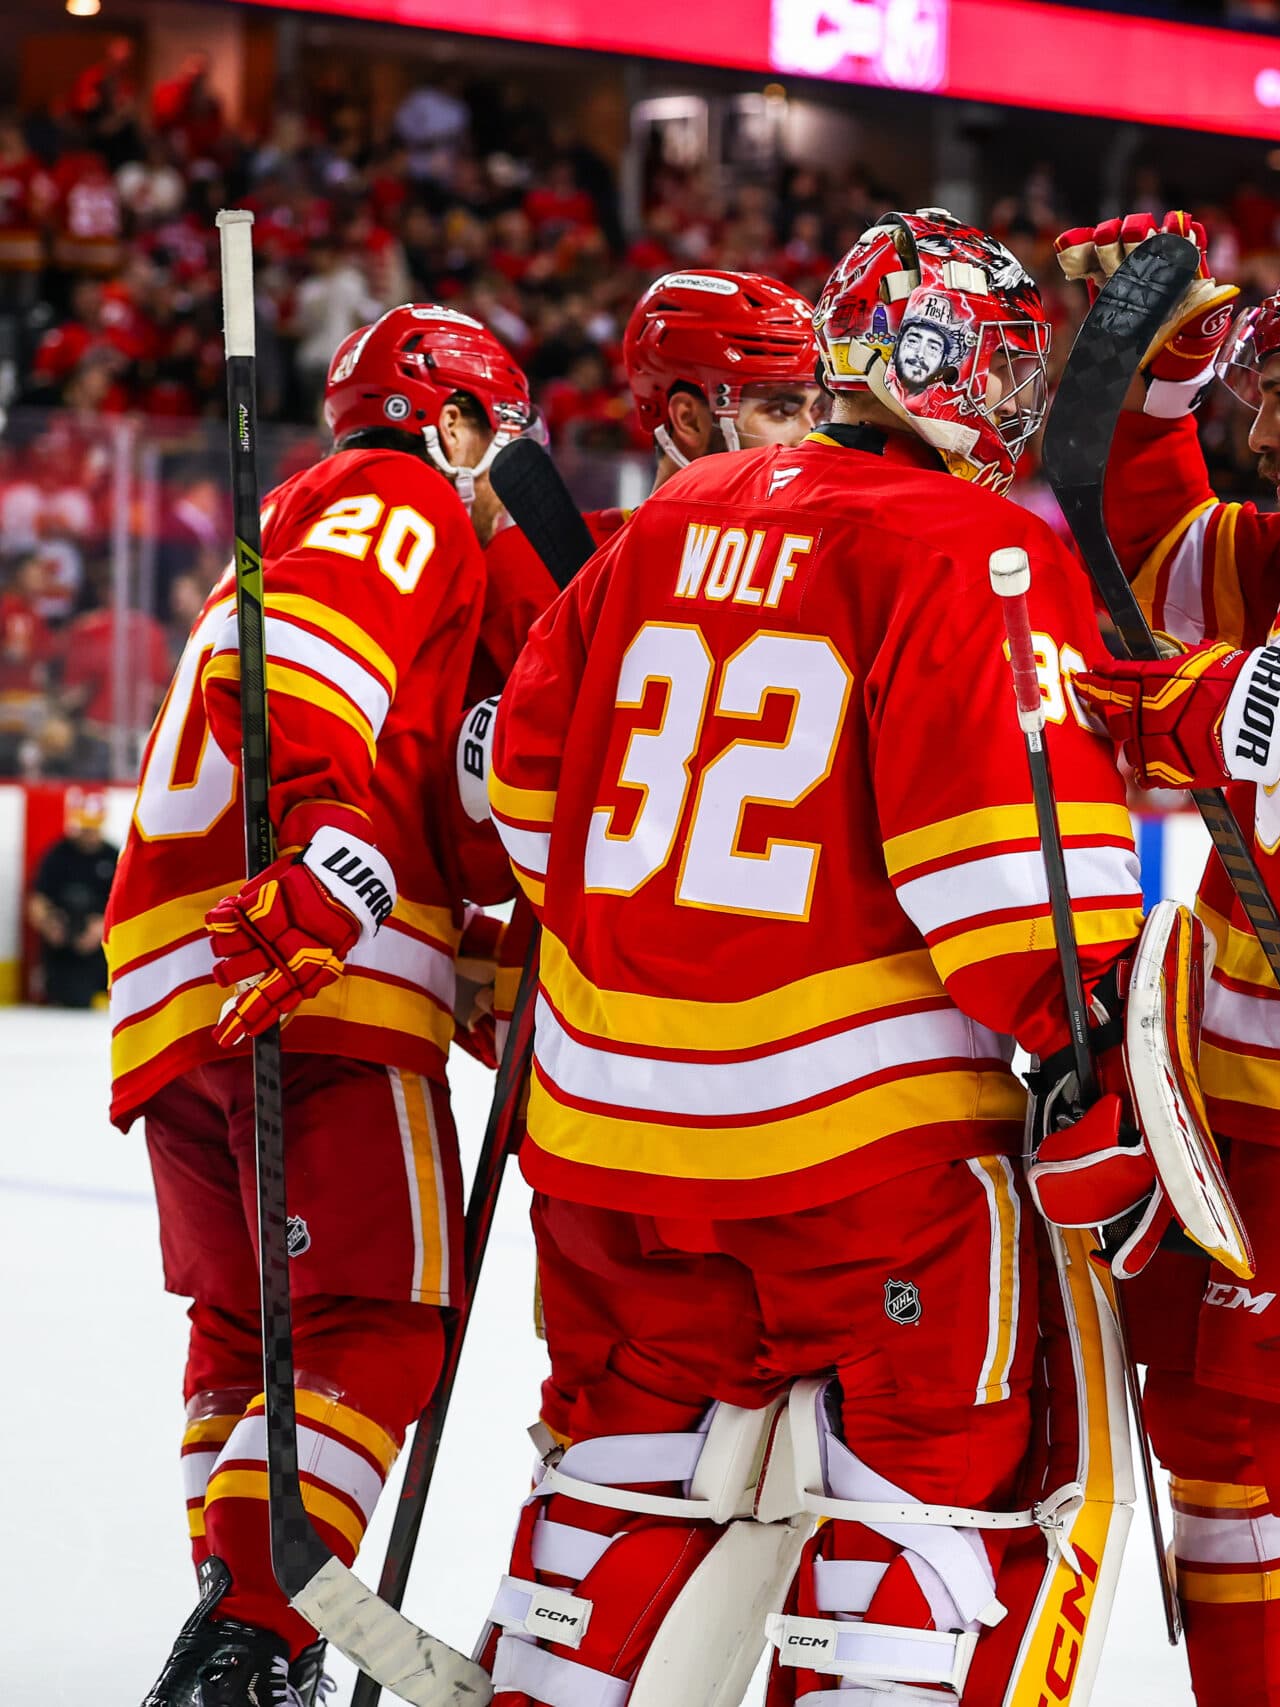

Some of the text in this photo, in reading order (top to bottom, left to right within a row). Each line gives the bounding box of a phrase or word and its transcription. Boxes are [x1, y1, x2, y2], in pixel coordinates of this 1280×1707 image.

[302, 493, 435, 594] 20
[673, 523, 813, 608] WOLF
[584, 620, 854, 922] 32
[892, 1291, 914, 1314] NHL
[1203, 1280, 1277, 1315] CM
[535, 1607, 579, 1626] CCM
[787, 1635, 829, 1648] CCM
[1037, 1541, 1098, 1707] CM
